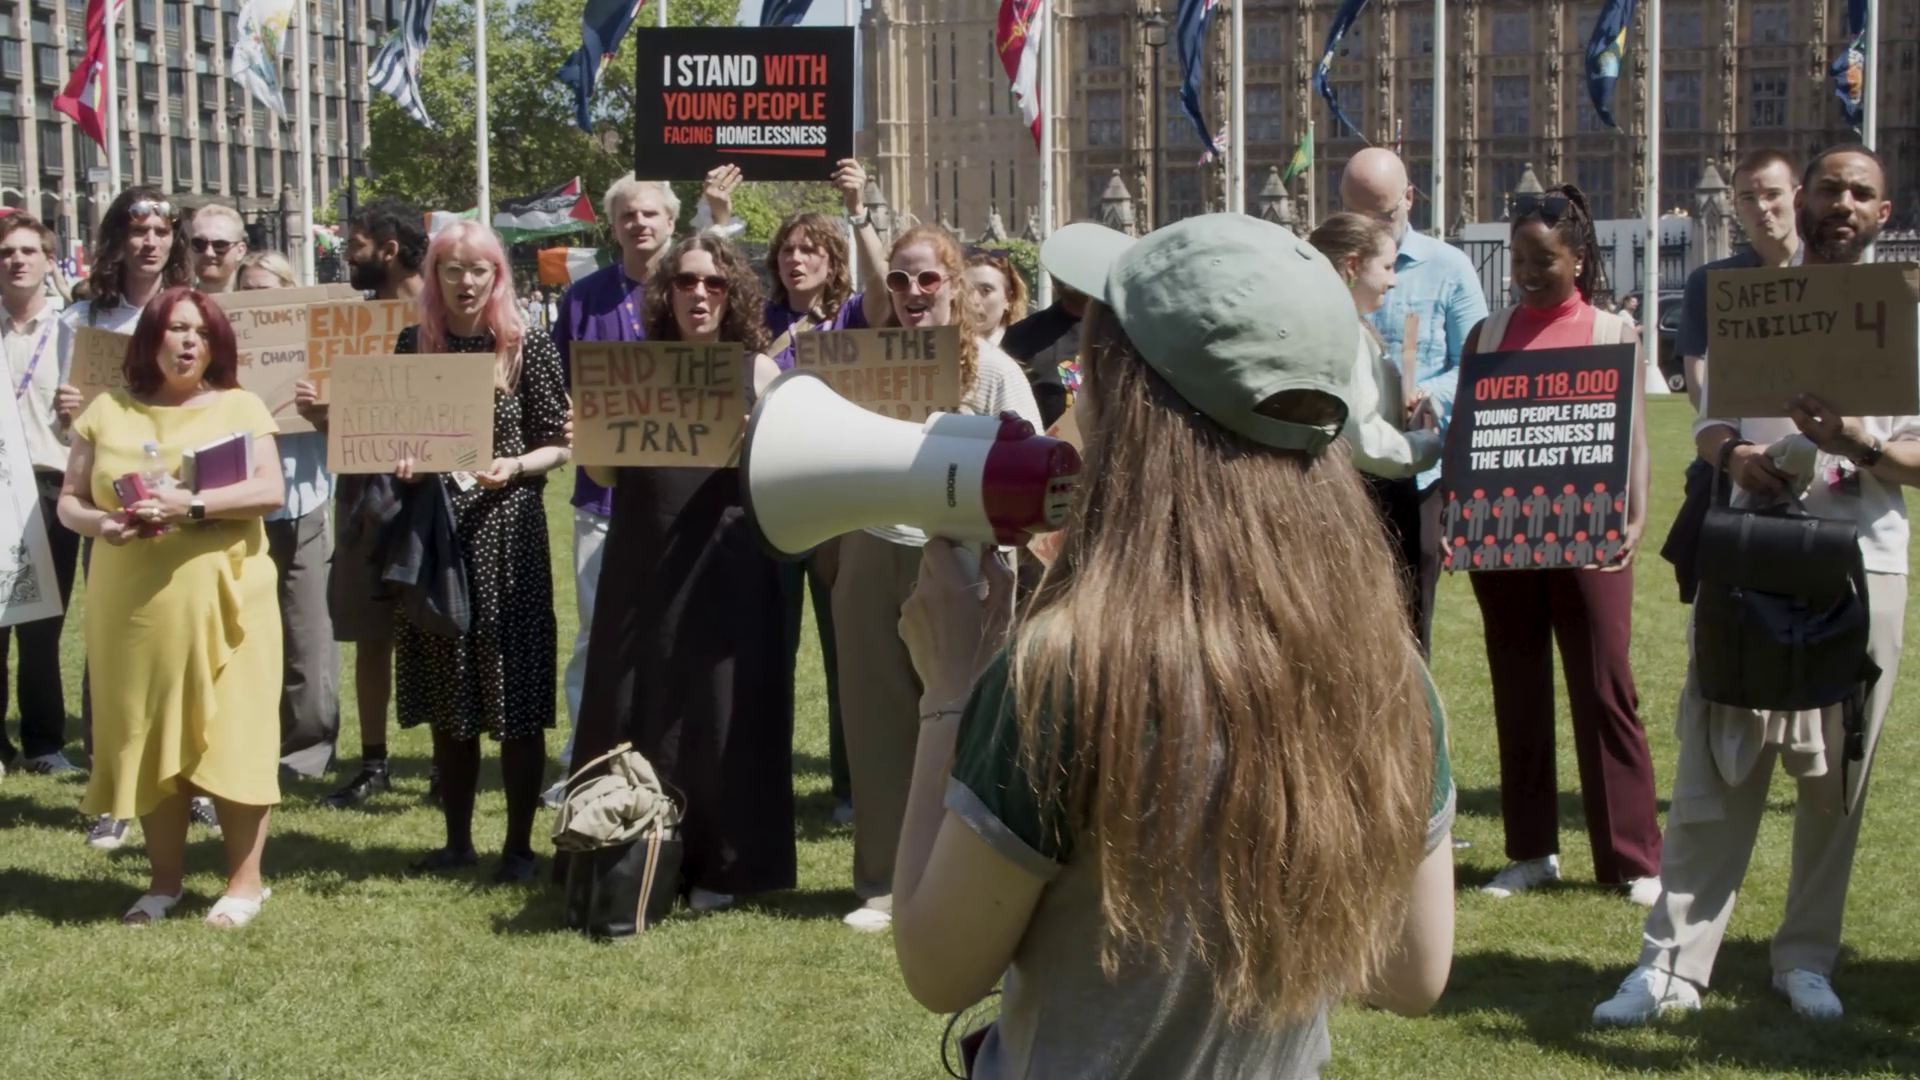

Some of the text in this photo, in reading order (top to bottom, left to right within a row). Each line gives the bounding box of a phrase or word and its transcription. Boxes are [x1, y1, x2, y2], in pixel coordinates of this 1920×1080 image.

[663, 55, 827, 87] I STAND WITH
[663, 92, 826, 120] YOUNG PEOPLE
[663, 126, 827, 145] FACING HOMELESSNESS
[249, 308, 293, 327] YOUNG
[310, 304, 373, 338] END
[380, 301, 421, 332] TH
[1716, 277, 1886, 349] SAFETY 4
[1717, 310, 1838, 339] STABILITY
[308, 333, 399, 370] BENEF
[797, 330, 936, 366] END THE
[577, 347, 734, 386] END THE
[350, 364, 421, 404] SAFE
[822, 365, 940, 402] ENEFIT
[1475, 368, 1619, 401] OVER 118,000
[341, 404, 478, 435] AFFORDABLE
[580, 386, 735, 421] BENEFIT
[1474, 402, 1616, 427] YOUNG PEOPLE FACED
[607, 421, 710, 456] TRAP
[1471, 422, 1615, 449] HOMELESSNESS IN
[341, 438, 433, 466] HOUSING
[1470, 444, 1614, 470] THE UK LAST YEAR
